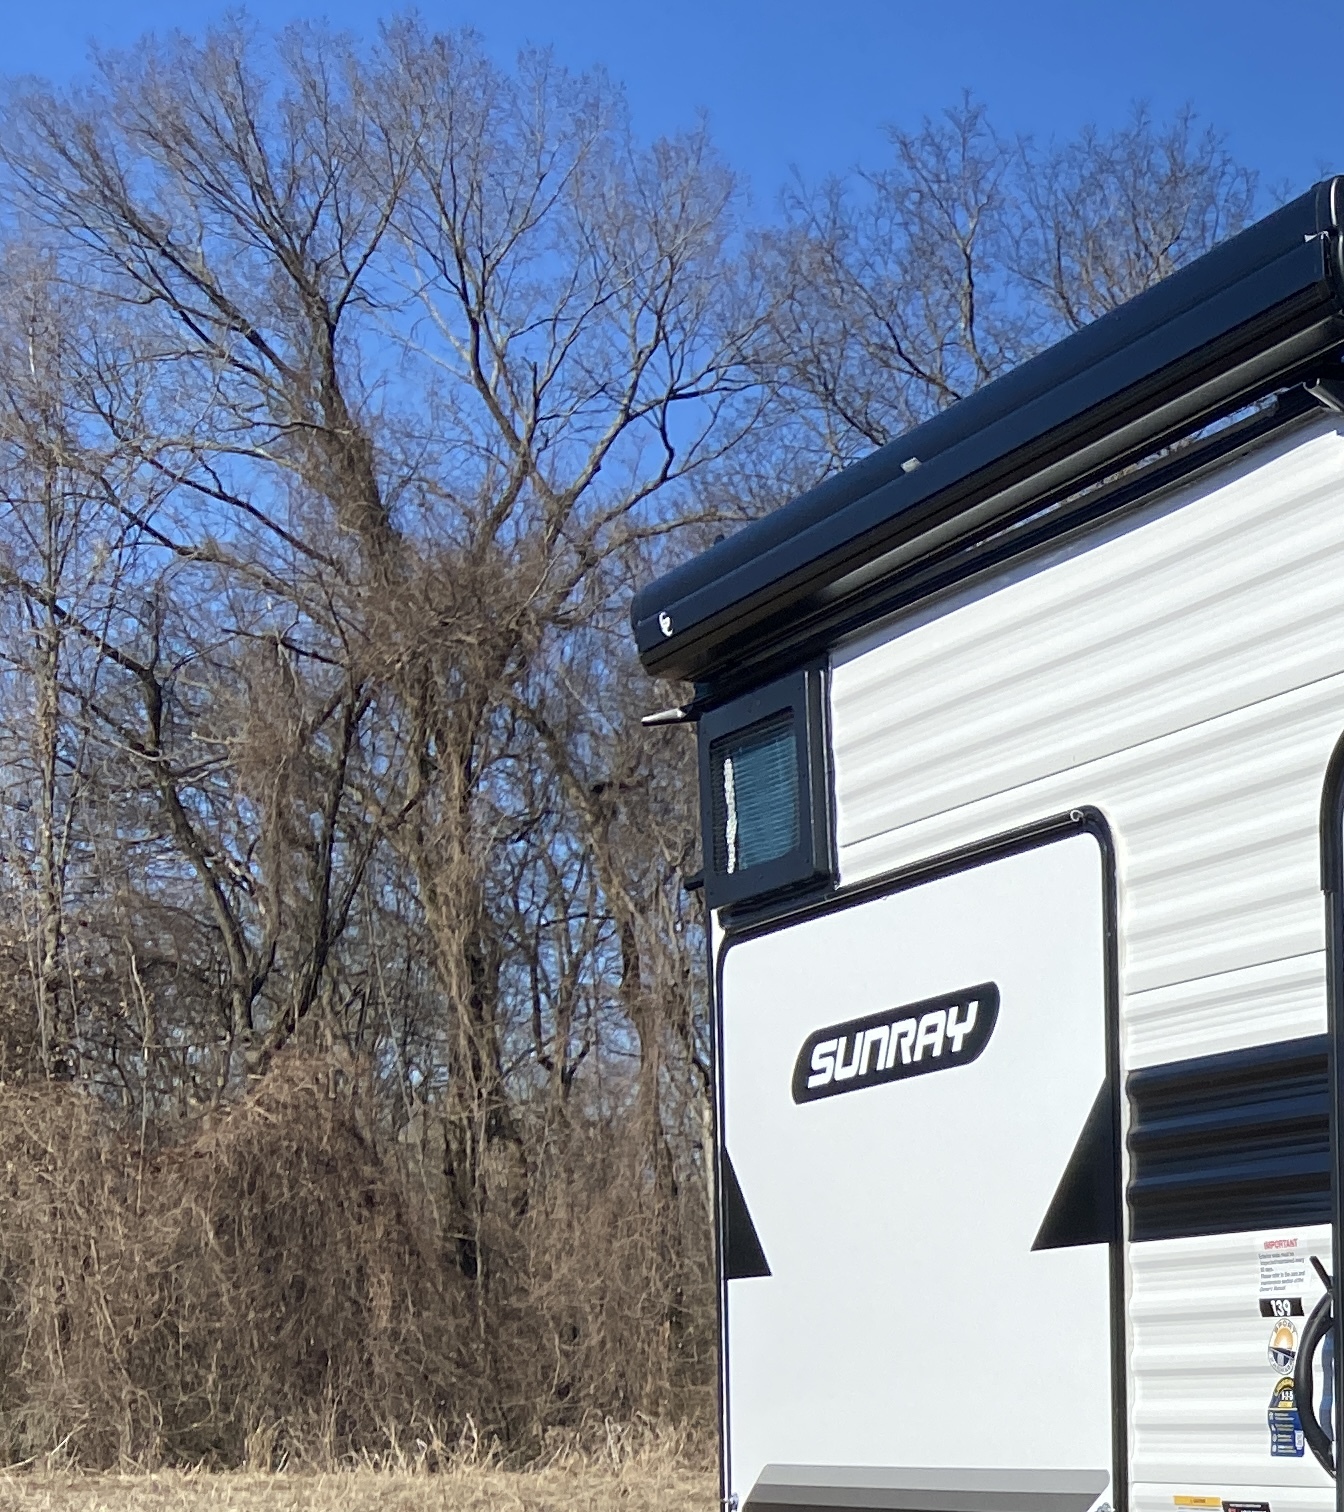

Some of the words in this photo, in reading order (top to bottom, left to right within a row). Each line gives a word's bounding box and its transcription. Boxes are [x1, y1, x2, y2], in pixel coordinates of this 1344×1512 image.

[807, 1000, 979, 1089] SUNRAY
[1263, 1238, 1299, 1250] IMPORTANT
[1270, 1299, 1291, 1317] 139
